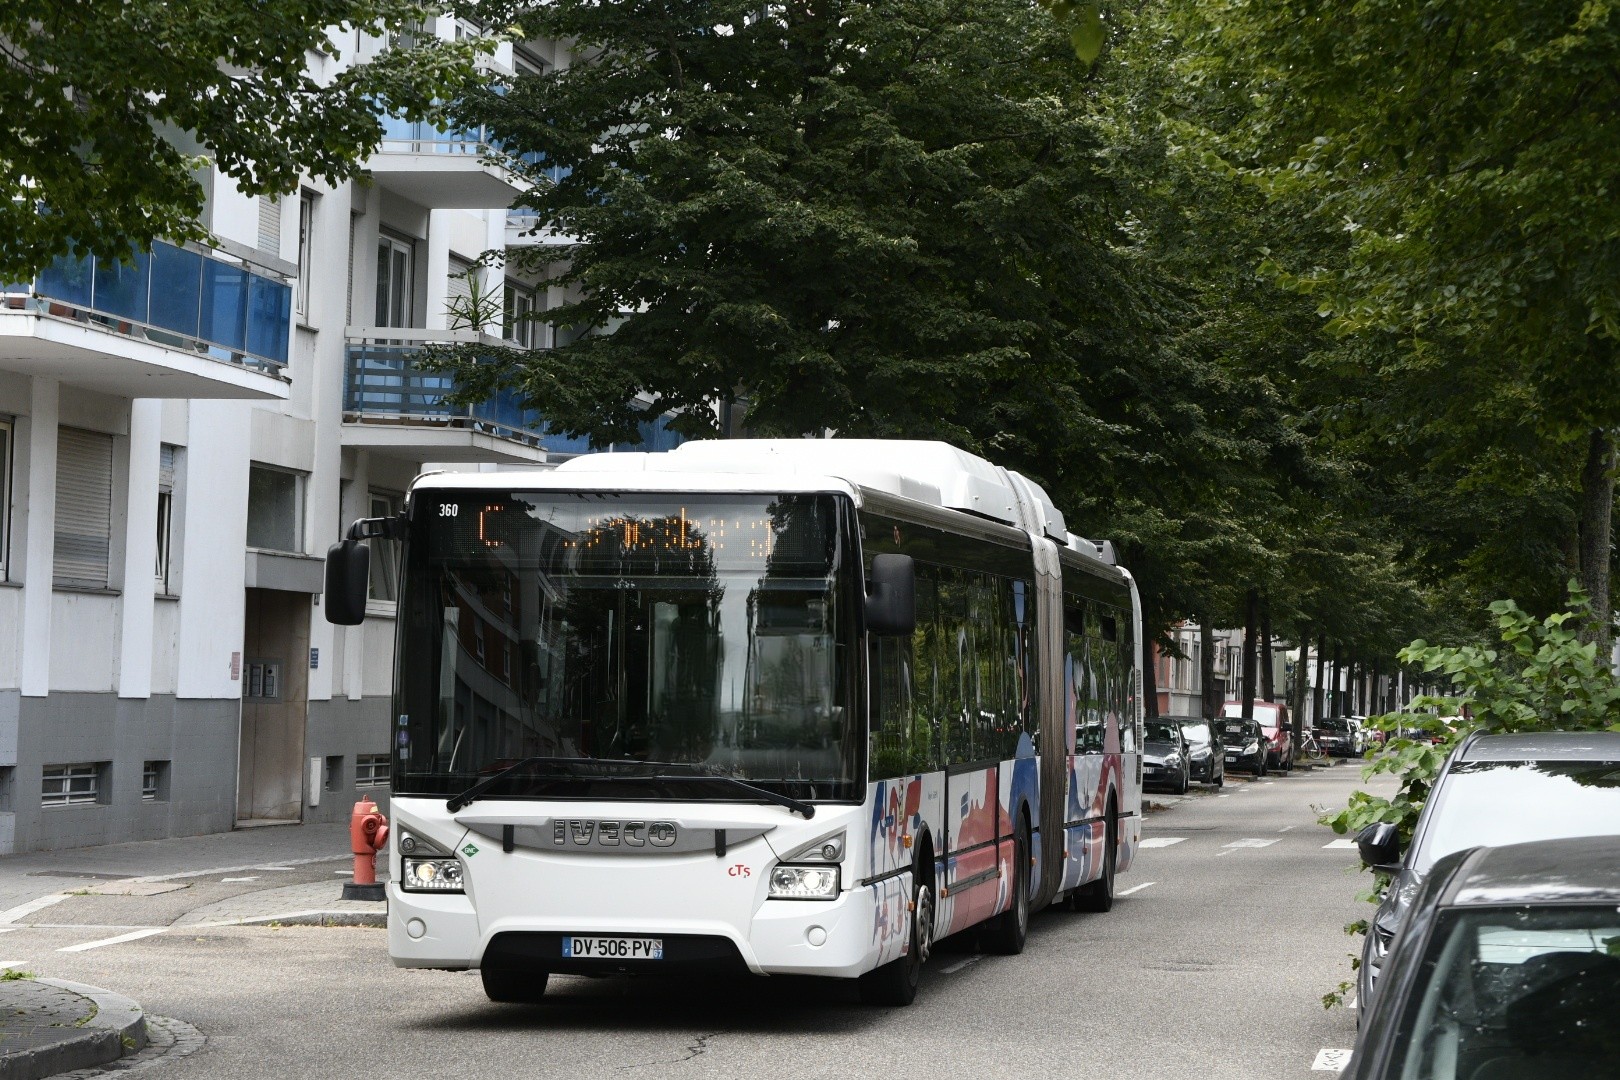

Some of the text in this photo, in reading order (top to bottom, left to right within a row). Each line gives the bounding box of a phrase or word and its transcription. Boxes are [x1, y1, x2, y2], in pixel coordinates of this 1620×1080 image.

[439, 503, 459, 517] 360
[553, 820, 678, 848] IVECO
[573, 938, 652, 958] DV-506-PV
[653, 949, 662, 958] 67
